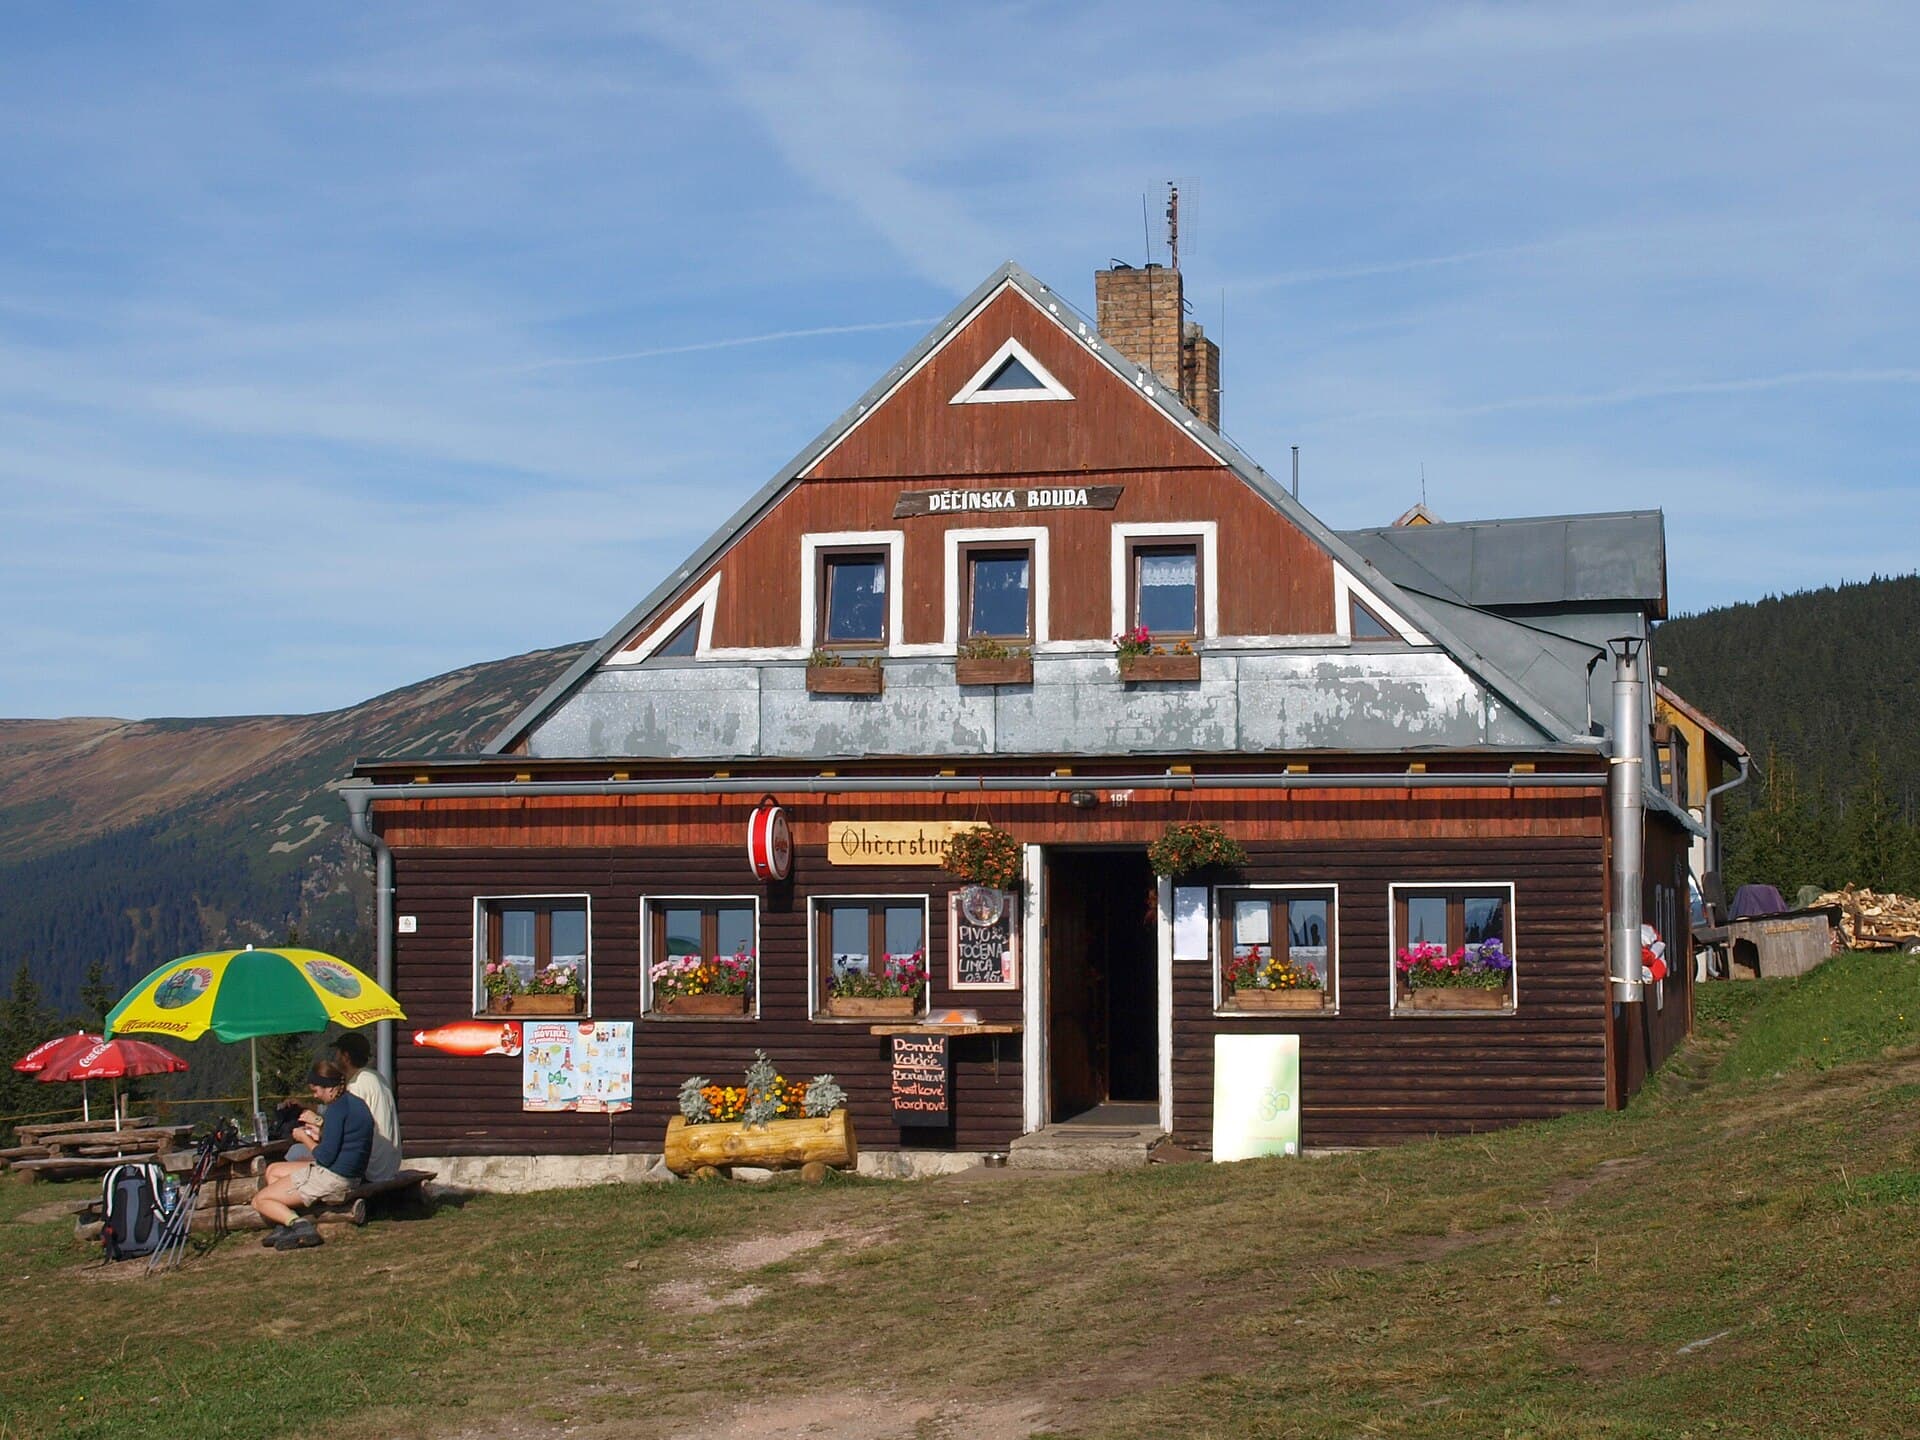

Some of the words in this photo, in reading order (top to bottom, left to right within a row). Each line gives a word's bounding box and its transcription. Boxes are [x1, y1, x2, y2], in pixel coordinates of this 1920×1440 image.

[929, 490, 1016, 511] DĚČÍNSKÁ
[1027, 489, 1088, 507] BOUDA
[841, 825, 953, 860] Občerstve
[959, 925, 991, 942] PIVO
[893, 1037, 945, 1054] Domácí
